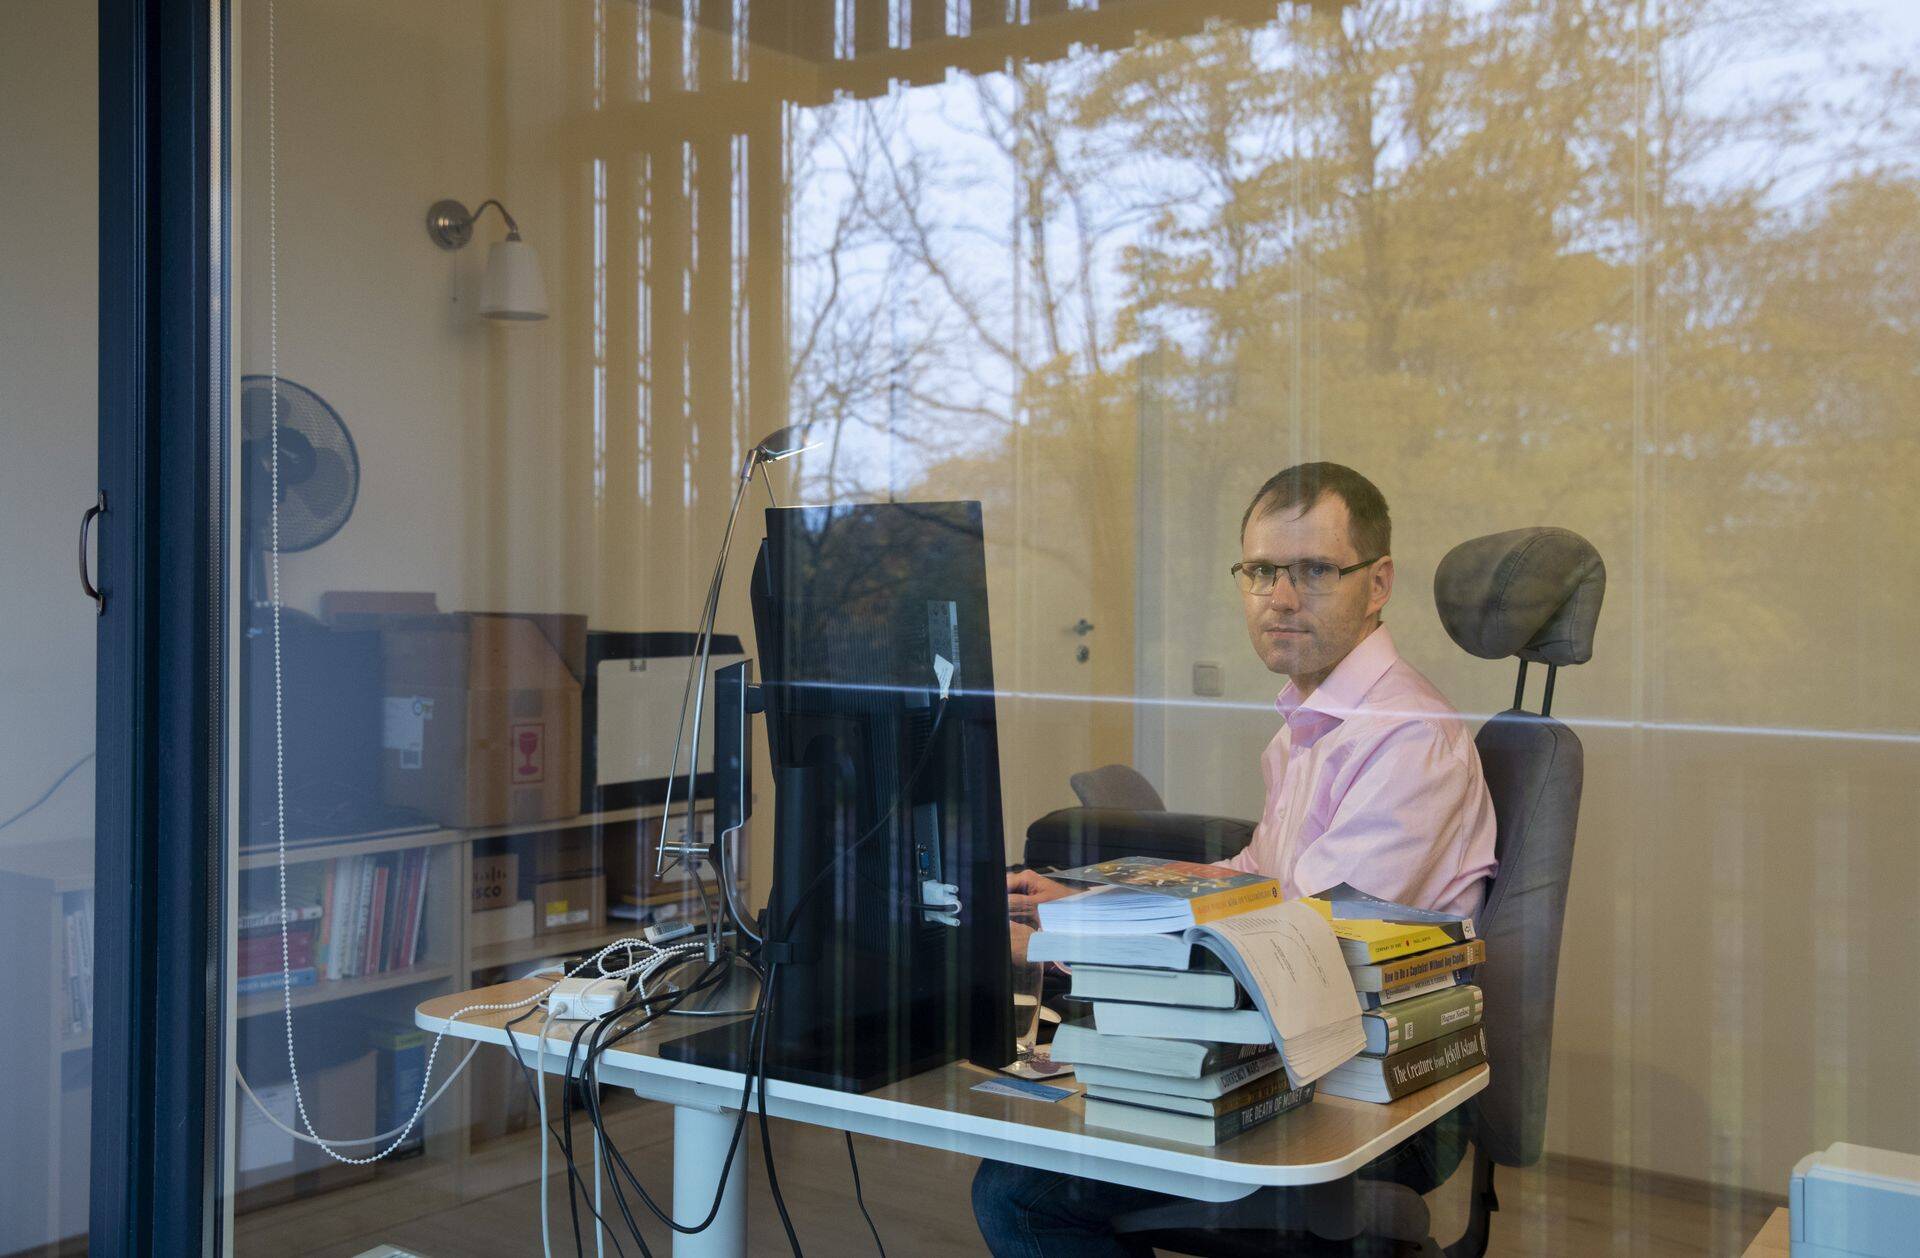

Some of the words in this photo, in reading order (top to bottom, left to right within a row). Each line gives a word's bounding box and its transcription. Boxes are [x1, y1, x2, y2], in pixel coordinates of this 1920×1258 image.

[1409, 961, 1429, 977] Capitalist
[1429, 958, 1444, 973] Without
[1452, 952, 1465, 967] Capital
[1393, 1064, 1407, 1085] The
[1407, 1057, 1434, 1079] Creature
[1433, 1055, 1446, 1069] from
[1444, 1043, 1461, 1069] Jekyll
[1460, 1034, 1479, 1058] Island
[1220, 1066, 1248, 1088] CURRENCY
[1241, 1107, 1254, 1126] THE
[1254, 1100, 1274, 1121] DEATH
[1274, 1096, 1282, 1111] OF
[1282, 1089, 1303, 1108] MONEY
